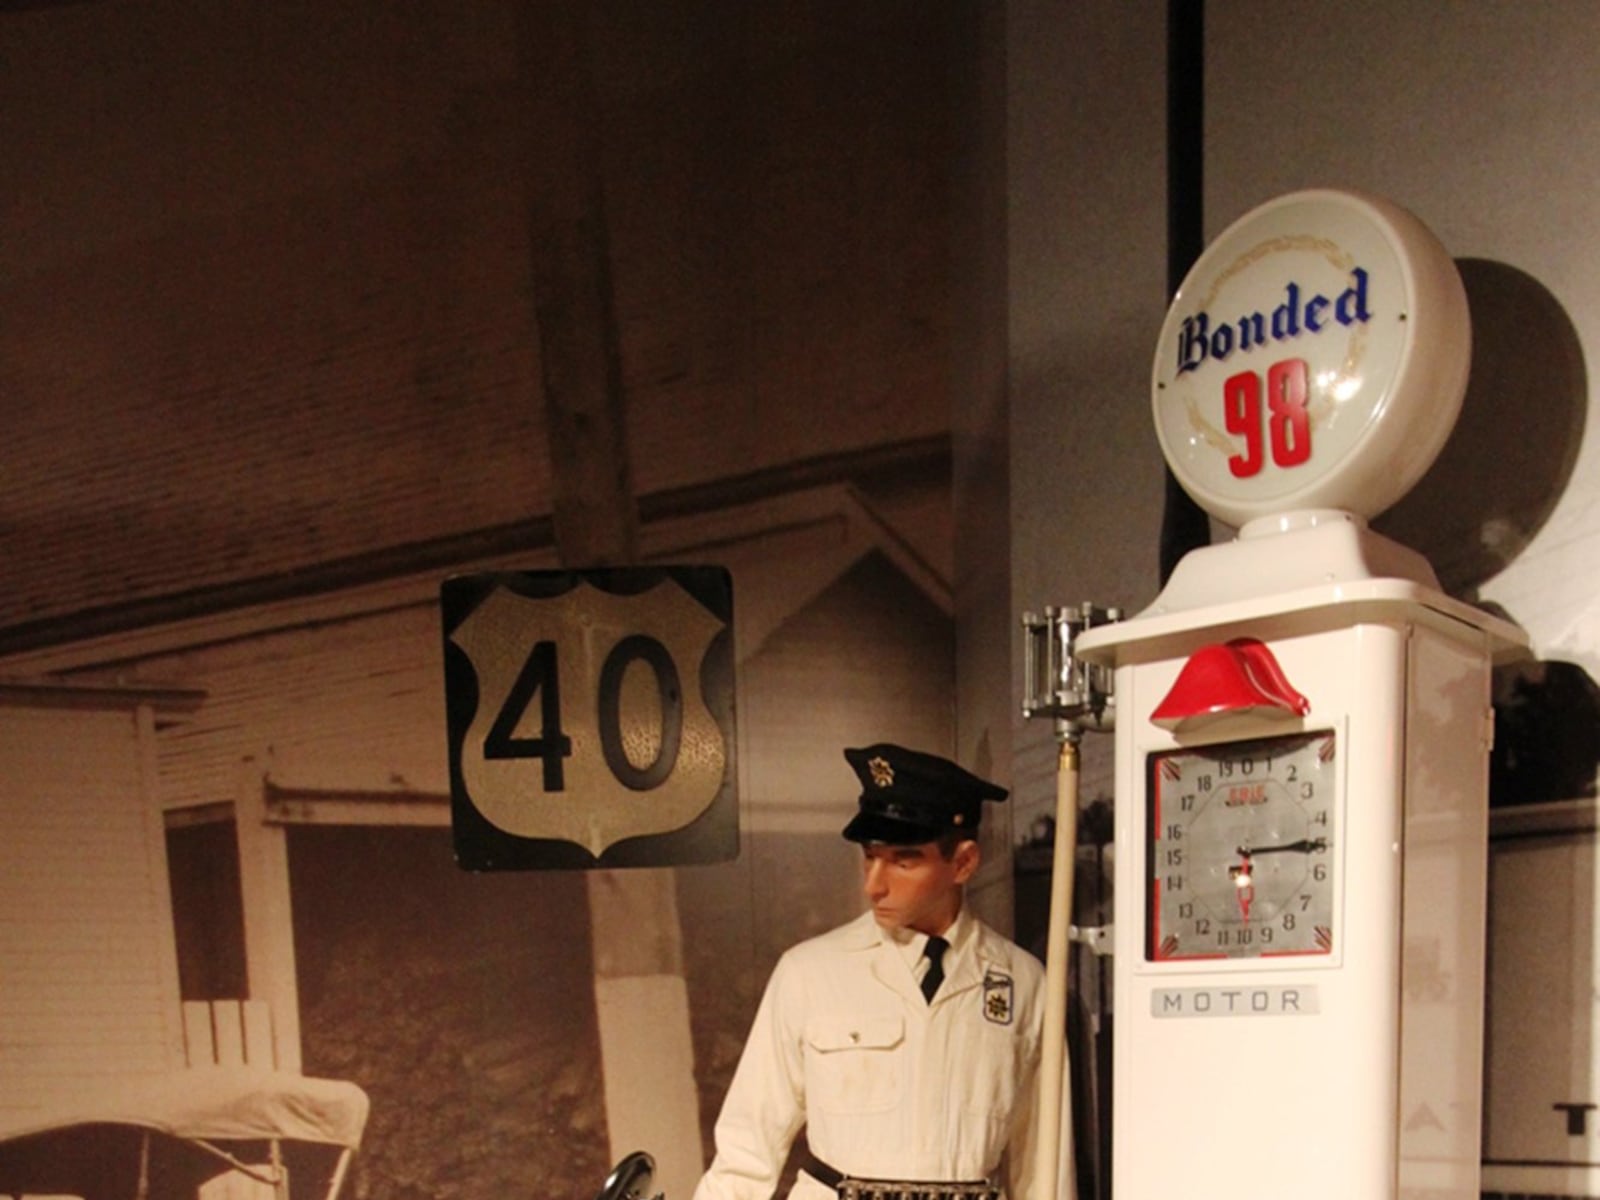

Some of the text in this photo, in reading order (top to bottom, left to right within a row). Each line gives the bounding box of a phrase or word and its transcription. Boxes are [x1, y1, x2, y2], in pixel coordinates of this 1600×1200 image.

[1176, 267, 1372, 378] Bonded
[1223, 357, 1311, 479] 98
[483, 634, 684, 793] 40
[1218, 758, 1233, 778] 19
[1265, 756, 1272, 773] 1
[1286, 765, 1298, 782] 2
[1197, 775, 1213, 792] 18
[1301, 782, 1314, 799] 3
[1181, 795, 1196, 811] 17
[1315, 810, 1327, 827] 4
[1167, 825, 1182, 842] 16
[1167, 847, 1182, 866] 15
[1313, 863, 1326, 883] 6
[1167, 875, 1183, 892] 14
[1178, 903, 1194, 920] 13
[1300, 894, 1312, 912] 7
[1195, 918, 1211, 936] 12
[1283, 913, 1296, 931] 8
[1217, 929, 1230, 946] 11
[1236, 927, 1253, 945] 10
[1261, 926, 1274, 944] 9
[1163, 989, 1301, 1013] MOTOR
